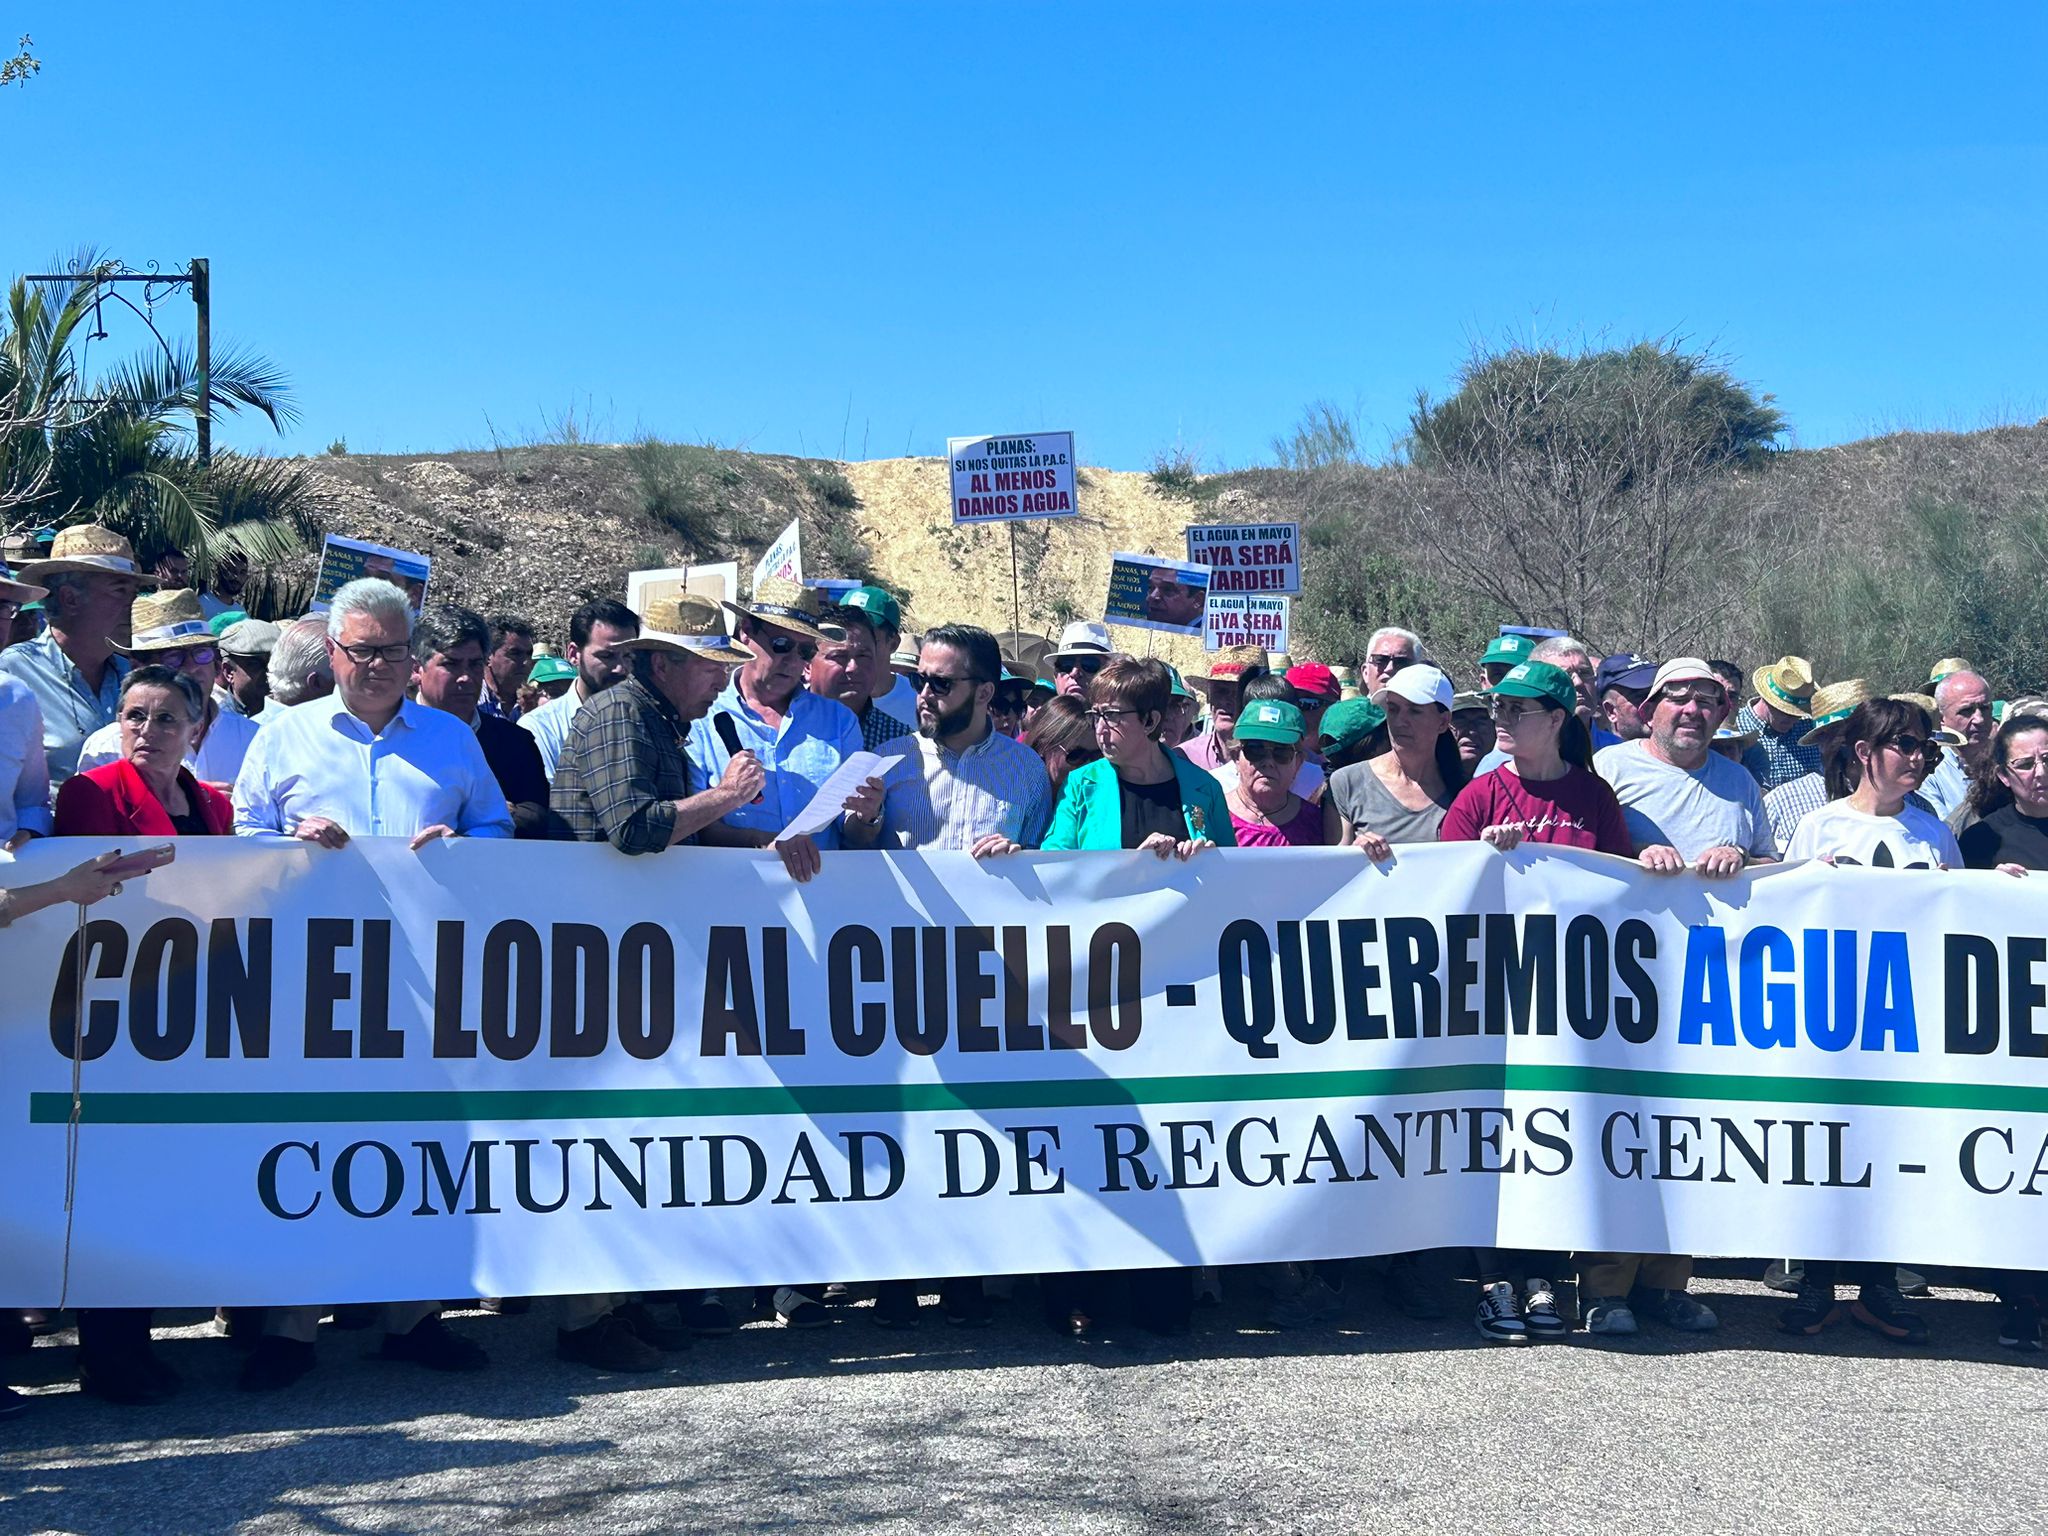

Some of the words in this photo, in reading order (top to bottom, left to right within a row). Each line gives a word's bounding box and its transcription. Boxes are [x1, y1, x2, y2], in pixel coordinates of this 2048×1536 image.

[986, 439, 1036, 456] PLANAS:
[955, 461, 966, 472] SI
[968, 459, 989, 471] NOS
[991, 457, 1027, 470] QUITAS
[1029, 455, 1041, 467] LA
[1043, 453, 1069, 467] P.A.C.
[971, 474, 991, 493] AL
[995, 469, 1056, 492] MENOS
[958, 495, 1018, 517] DANOS
[1022, 491, 1070, 513] AGUA
[1193, 530, 1204, 542] EL
[1207, 529, 1239, 541] AGUA
[1241, 529, 1256, 541] EN
[1258, 527, 1292, 540] MAYO
[1238, 540, 1293, 566] SERÁ
[1210, 599, 1218, 608] EL
[1220, 599, 1245, 610] AGUA
[1260, 600, 1284, 611] MAYO
[1243, 611, 1283, 631] SERÁ
[50, 917, 273, 1062] CON
[303, 918, 405, 1059] EL
[432, 918, 675, 1062] LODO
[700, 926, 806, 1057] AL
[827, 921, 1143, 1057] CUELLO
[1166, 984, 1196, 1007] -
[1218, 913, 1660, 1059] QUEREMOS
[1677, 924, 1920, 1053] AGUA
[256, 1131, 905, 1221] COMUNIDAD
[934, 1125, 1065, 1198] DE
[1093, 1107, 1574, 1192] REGANTES
[1601, 1110, 1873, 1189] GENIL
[1899, 1163, 1926, 1175] -
